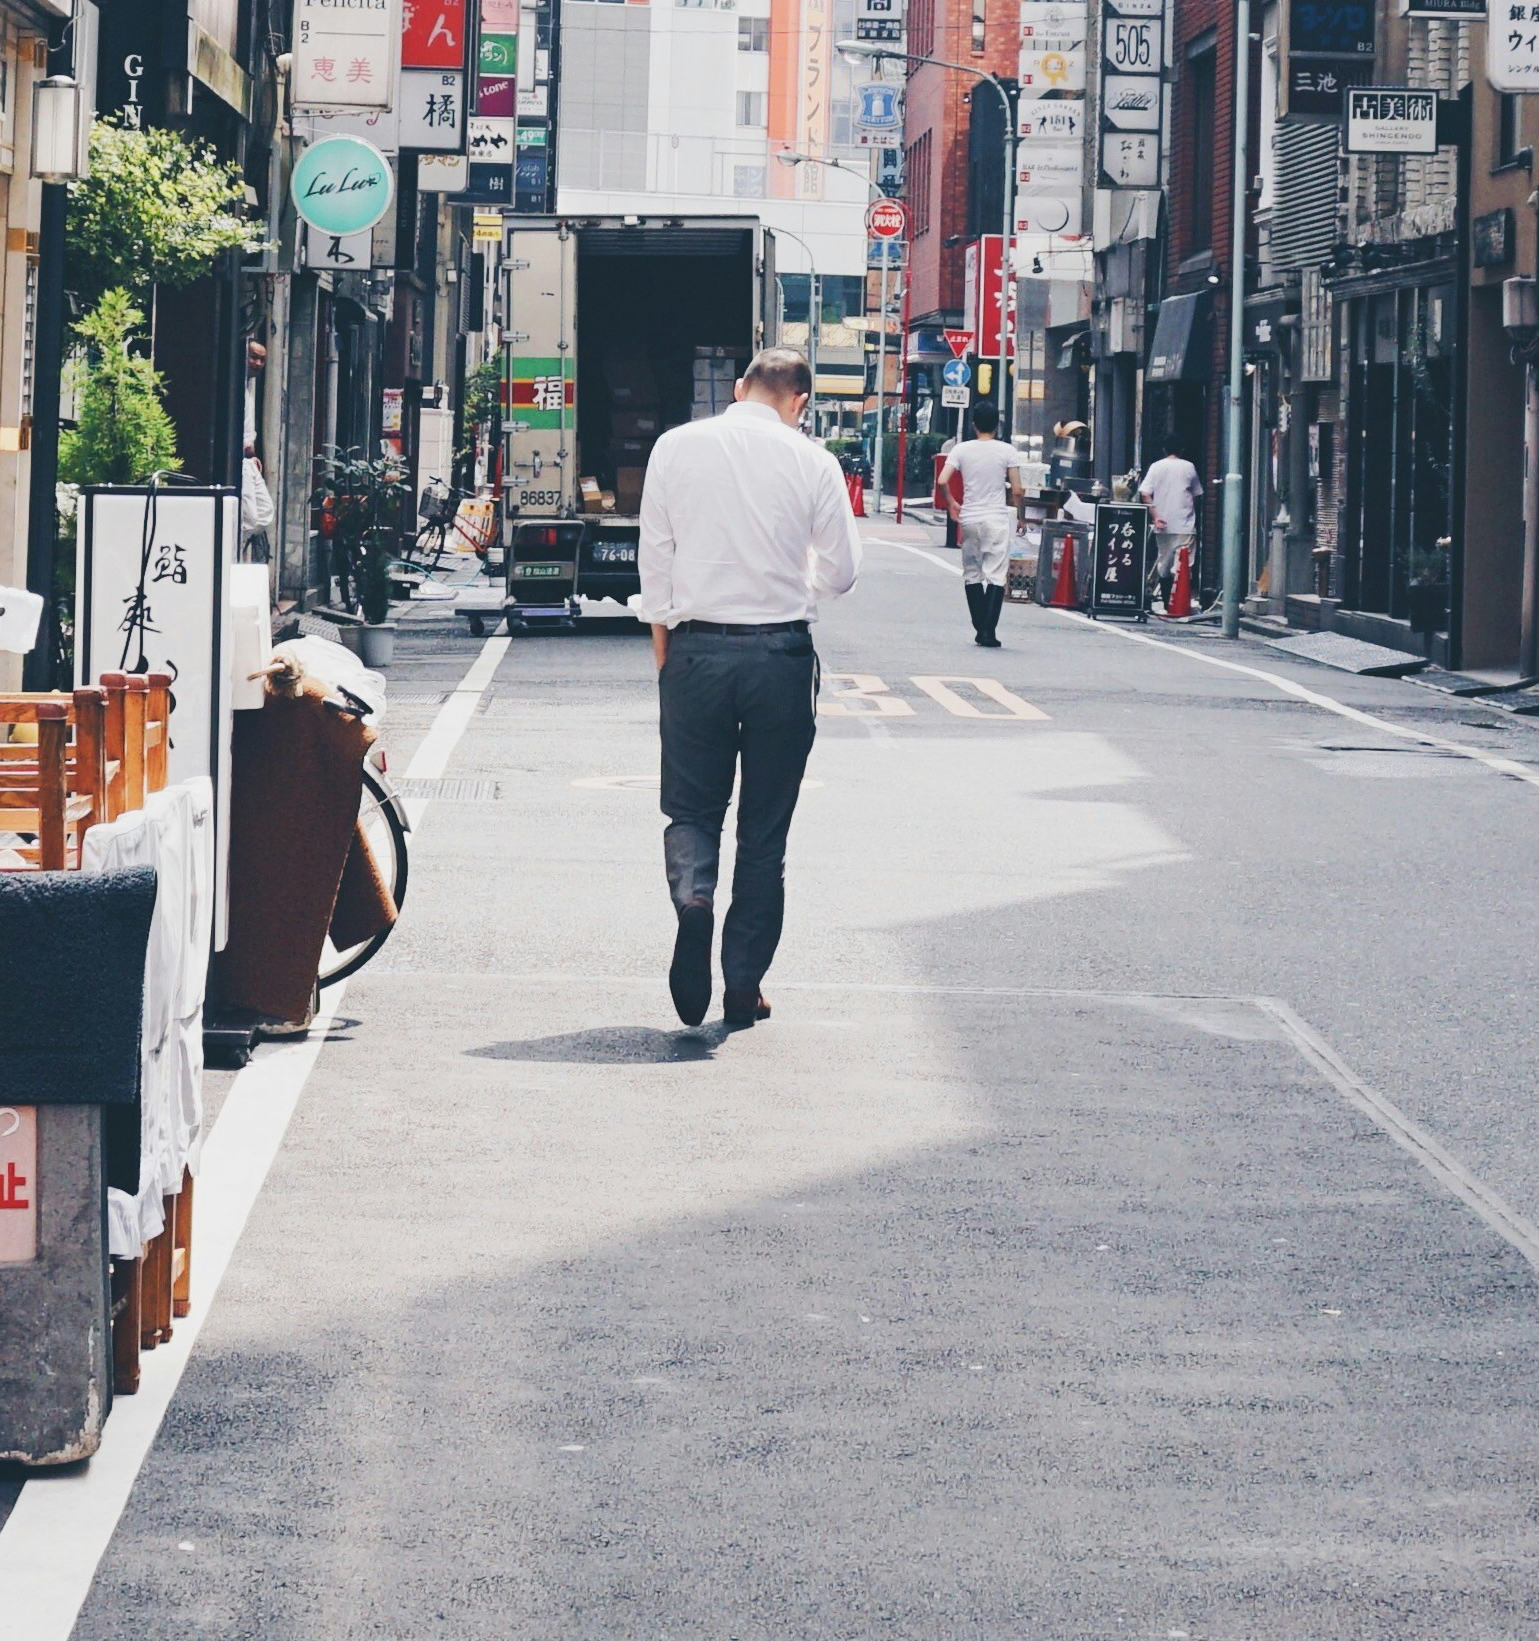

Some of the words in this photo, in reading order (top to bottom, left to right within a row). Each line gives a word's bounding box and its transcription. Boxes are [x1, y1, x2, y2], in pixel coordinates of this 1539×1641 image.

[1424, 0, 1458, 8] MIURA
[1357, 42, 1373, 52] B2
[442, 74, 456, 86] B2
[1353, 96, 1432, 121] 古美術
[1361, 132, 1423, 140] SHINGENDO
[152, 543, 187, 585] 鮨
